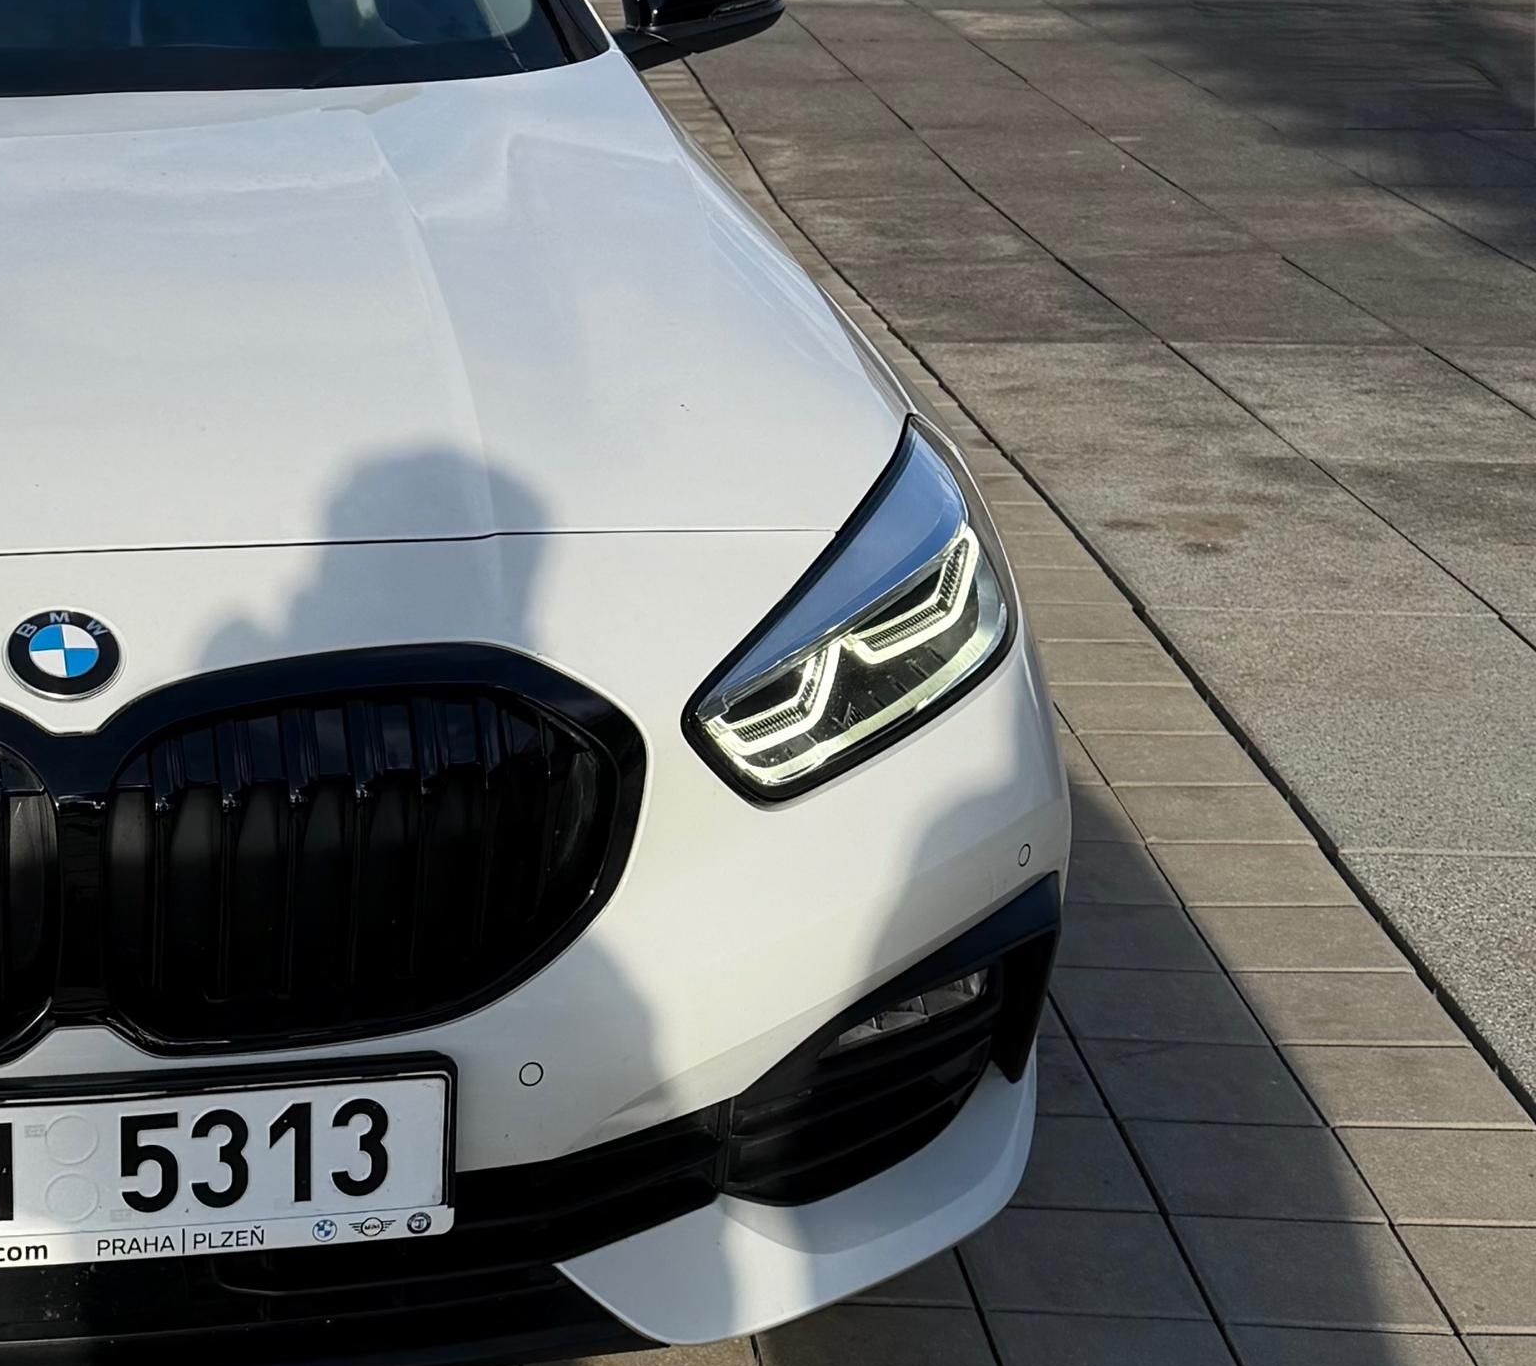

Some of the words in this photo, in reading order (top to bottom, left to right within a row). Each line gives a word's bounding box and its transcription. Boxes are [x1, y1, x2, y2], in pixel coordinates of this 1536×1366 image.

[15, 611, 109, 640] BMW
[120, 1097, 390, 1213] 5313
[97, 1235, 175, 1256] PRAHA
[193, 1225, 265, 1249] PLZEŇ
